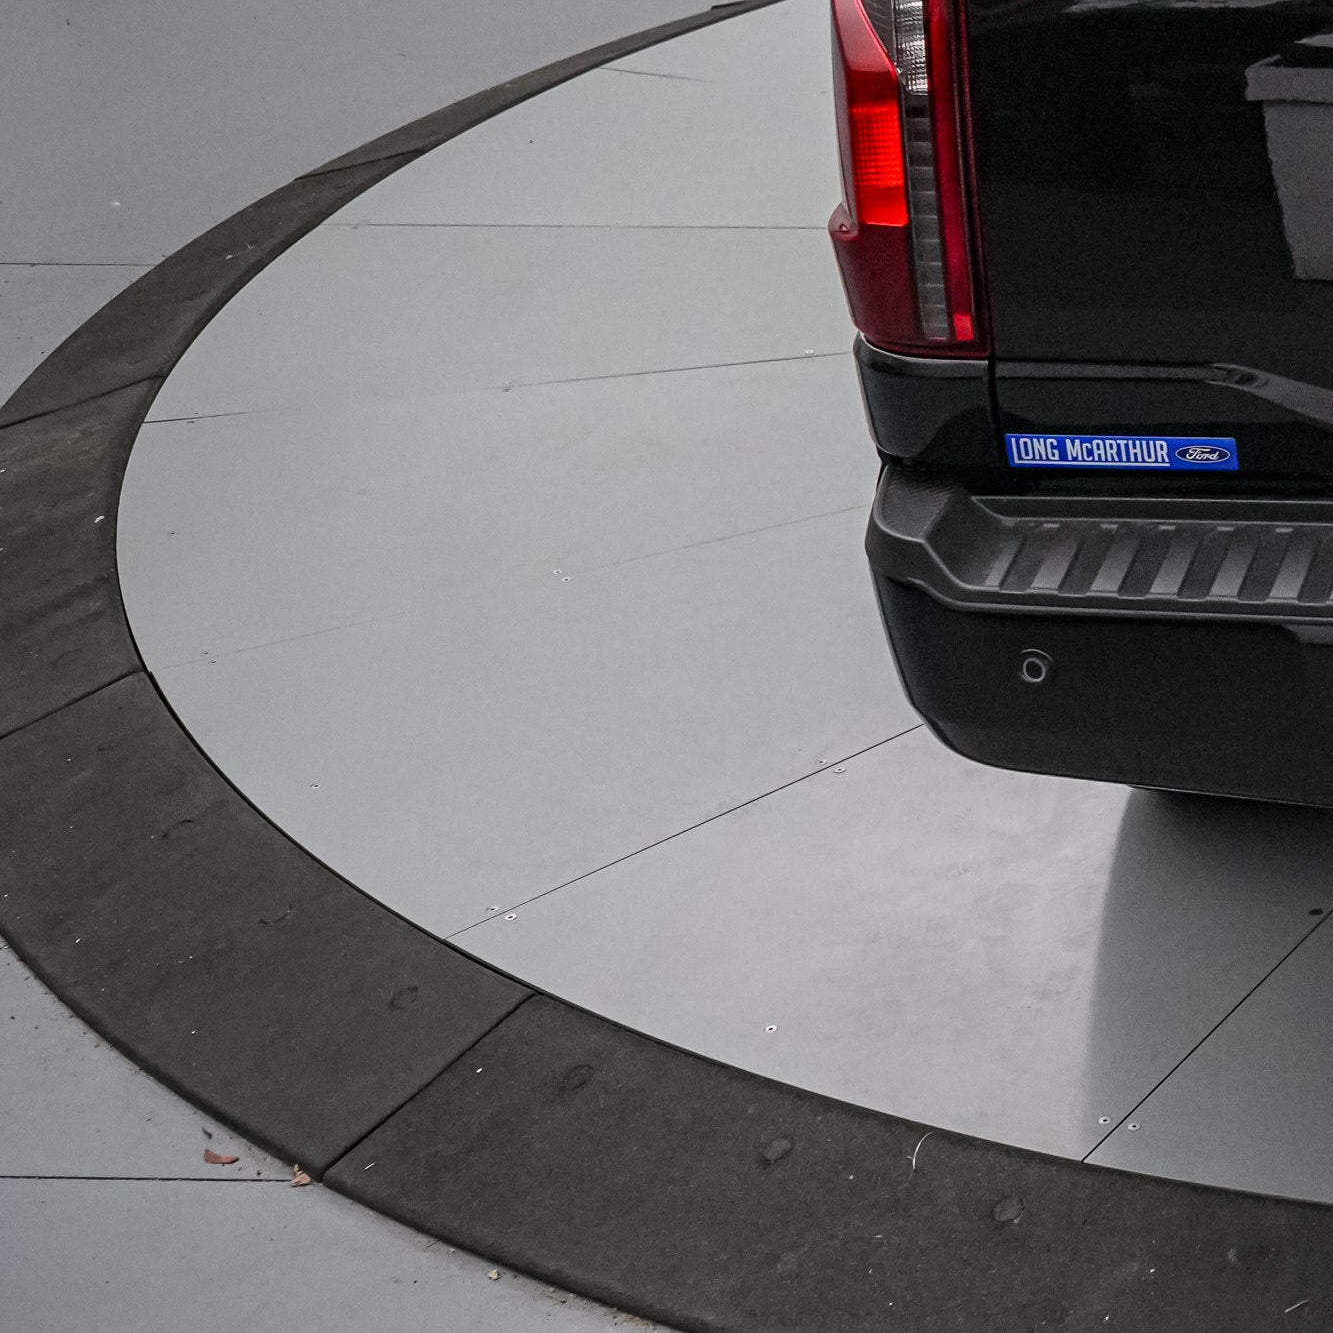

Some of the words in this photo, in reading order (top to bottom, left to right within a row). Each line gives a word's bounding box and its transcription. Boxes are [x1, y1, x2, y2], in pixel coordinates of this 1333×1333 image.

[1010, 437, 1060, 464] LONG
[1066, 438, 1170, 463] McARTHUR
[1185, 447, 1220, 461] Ford
